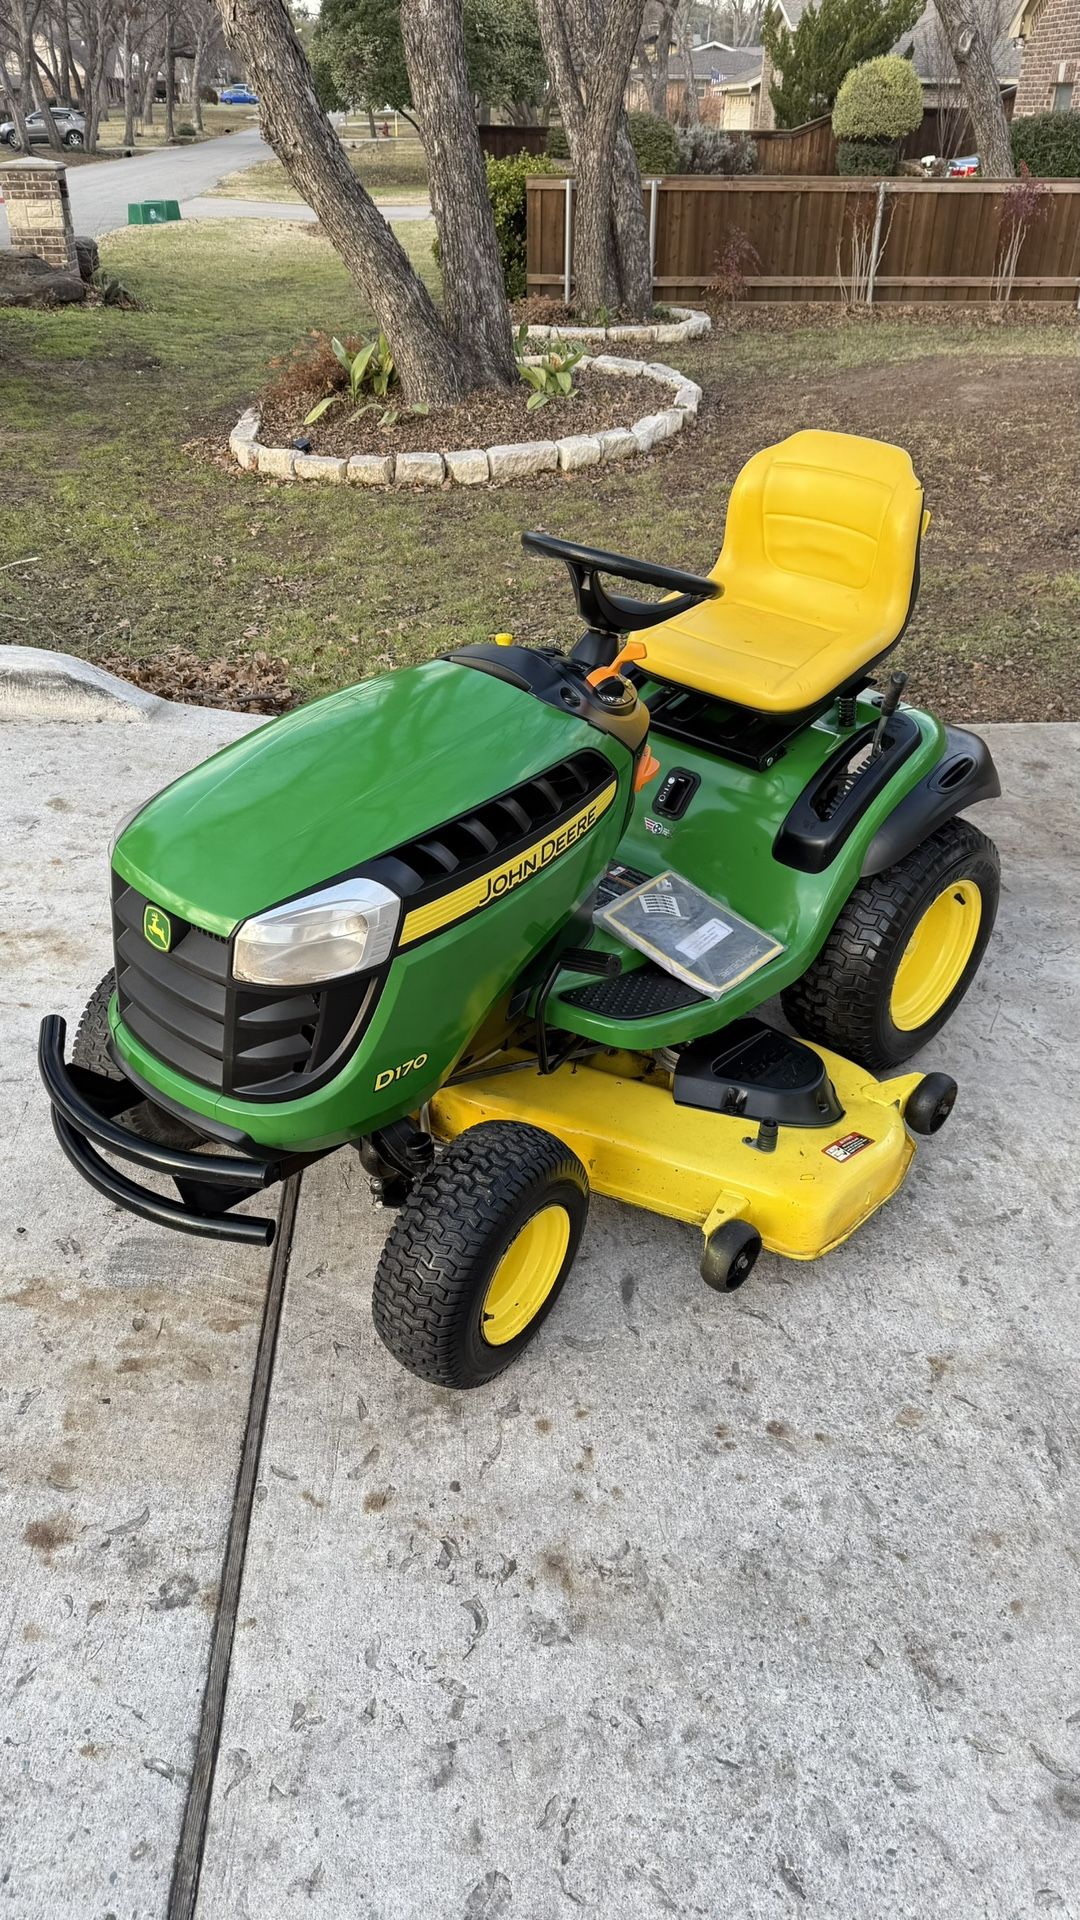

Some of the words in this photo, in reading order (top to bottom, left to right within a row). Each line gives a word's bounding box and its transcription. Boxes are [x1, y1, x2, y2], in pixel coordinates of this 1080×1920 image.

[479, 854, 537, 905] JOHN
[541, 806, 597, 865] DEERE
[374, 1053, 428, 1092] D170
